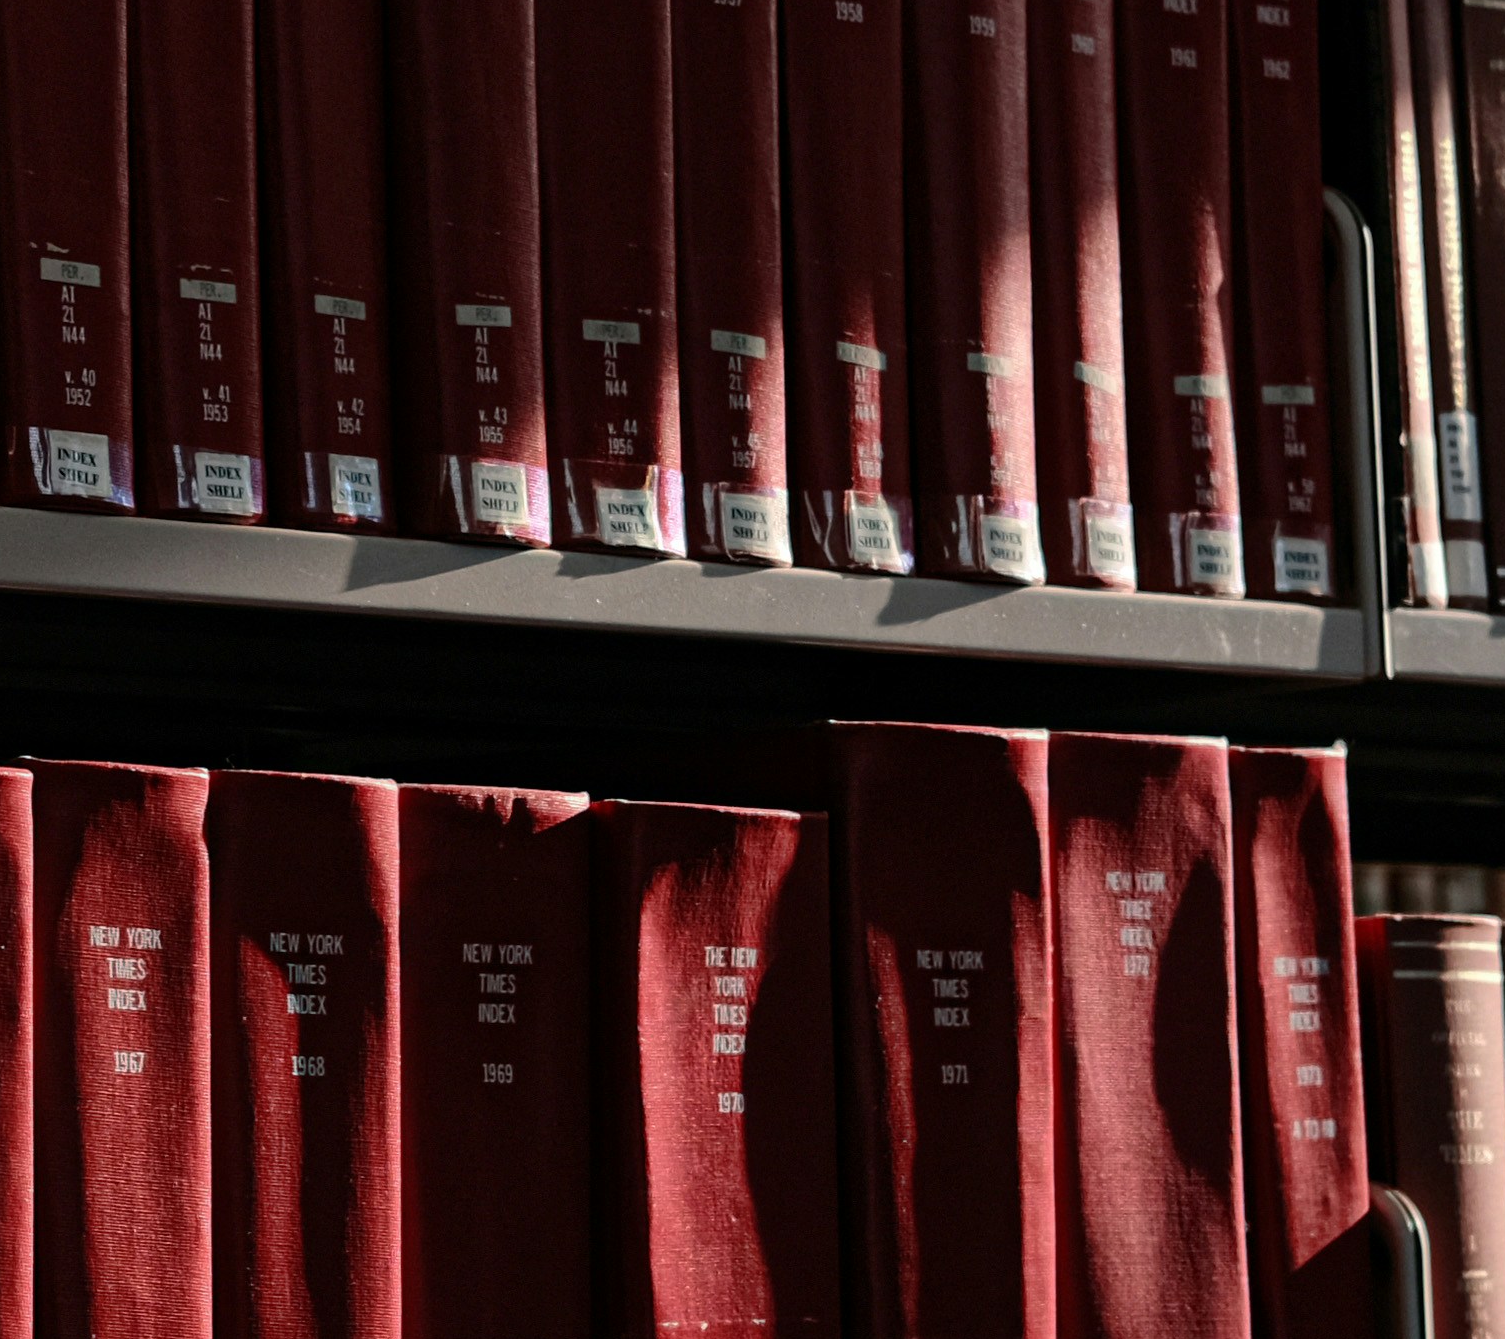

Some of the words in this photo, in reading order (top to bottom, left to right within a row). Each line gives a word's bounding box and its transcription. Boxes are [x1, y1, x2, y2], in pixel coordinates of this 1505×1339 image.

[463, 943, 492, 963] NEW
[498, 944, 533, 964] YORK
[479, 973, 516, 994] TIMES
[479, 1003, 515, 1024] INDEX
[482, 1063, 513, 1084] 1969
